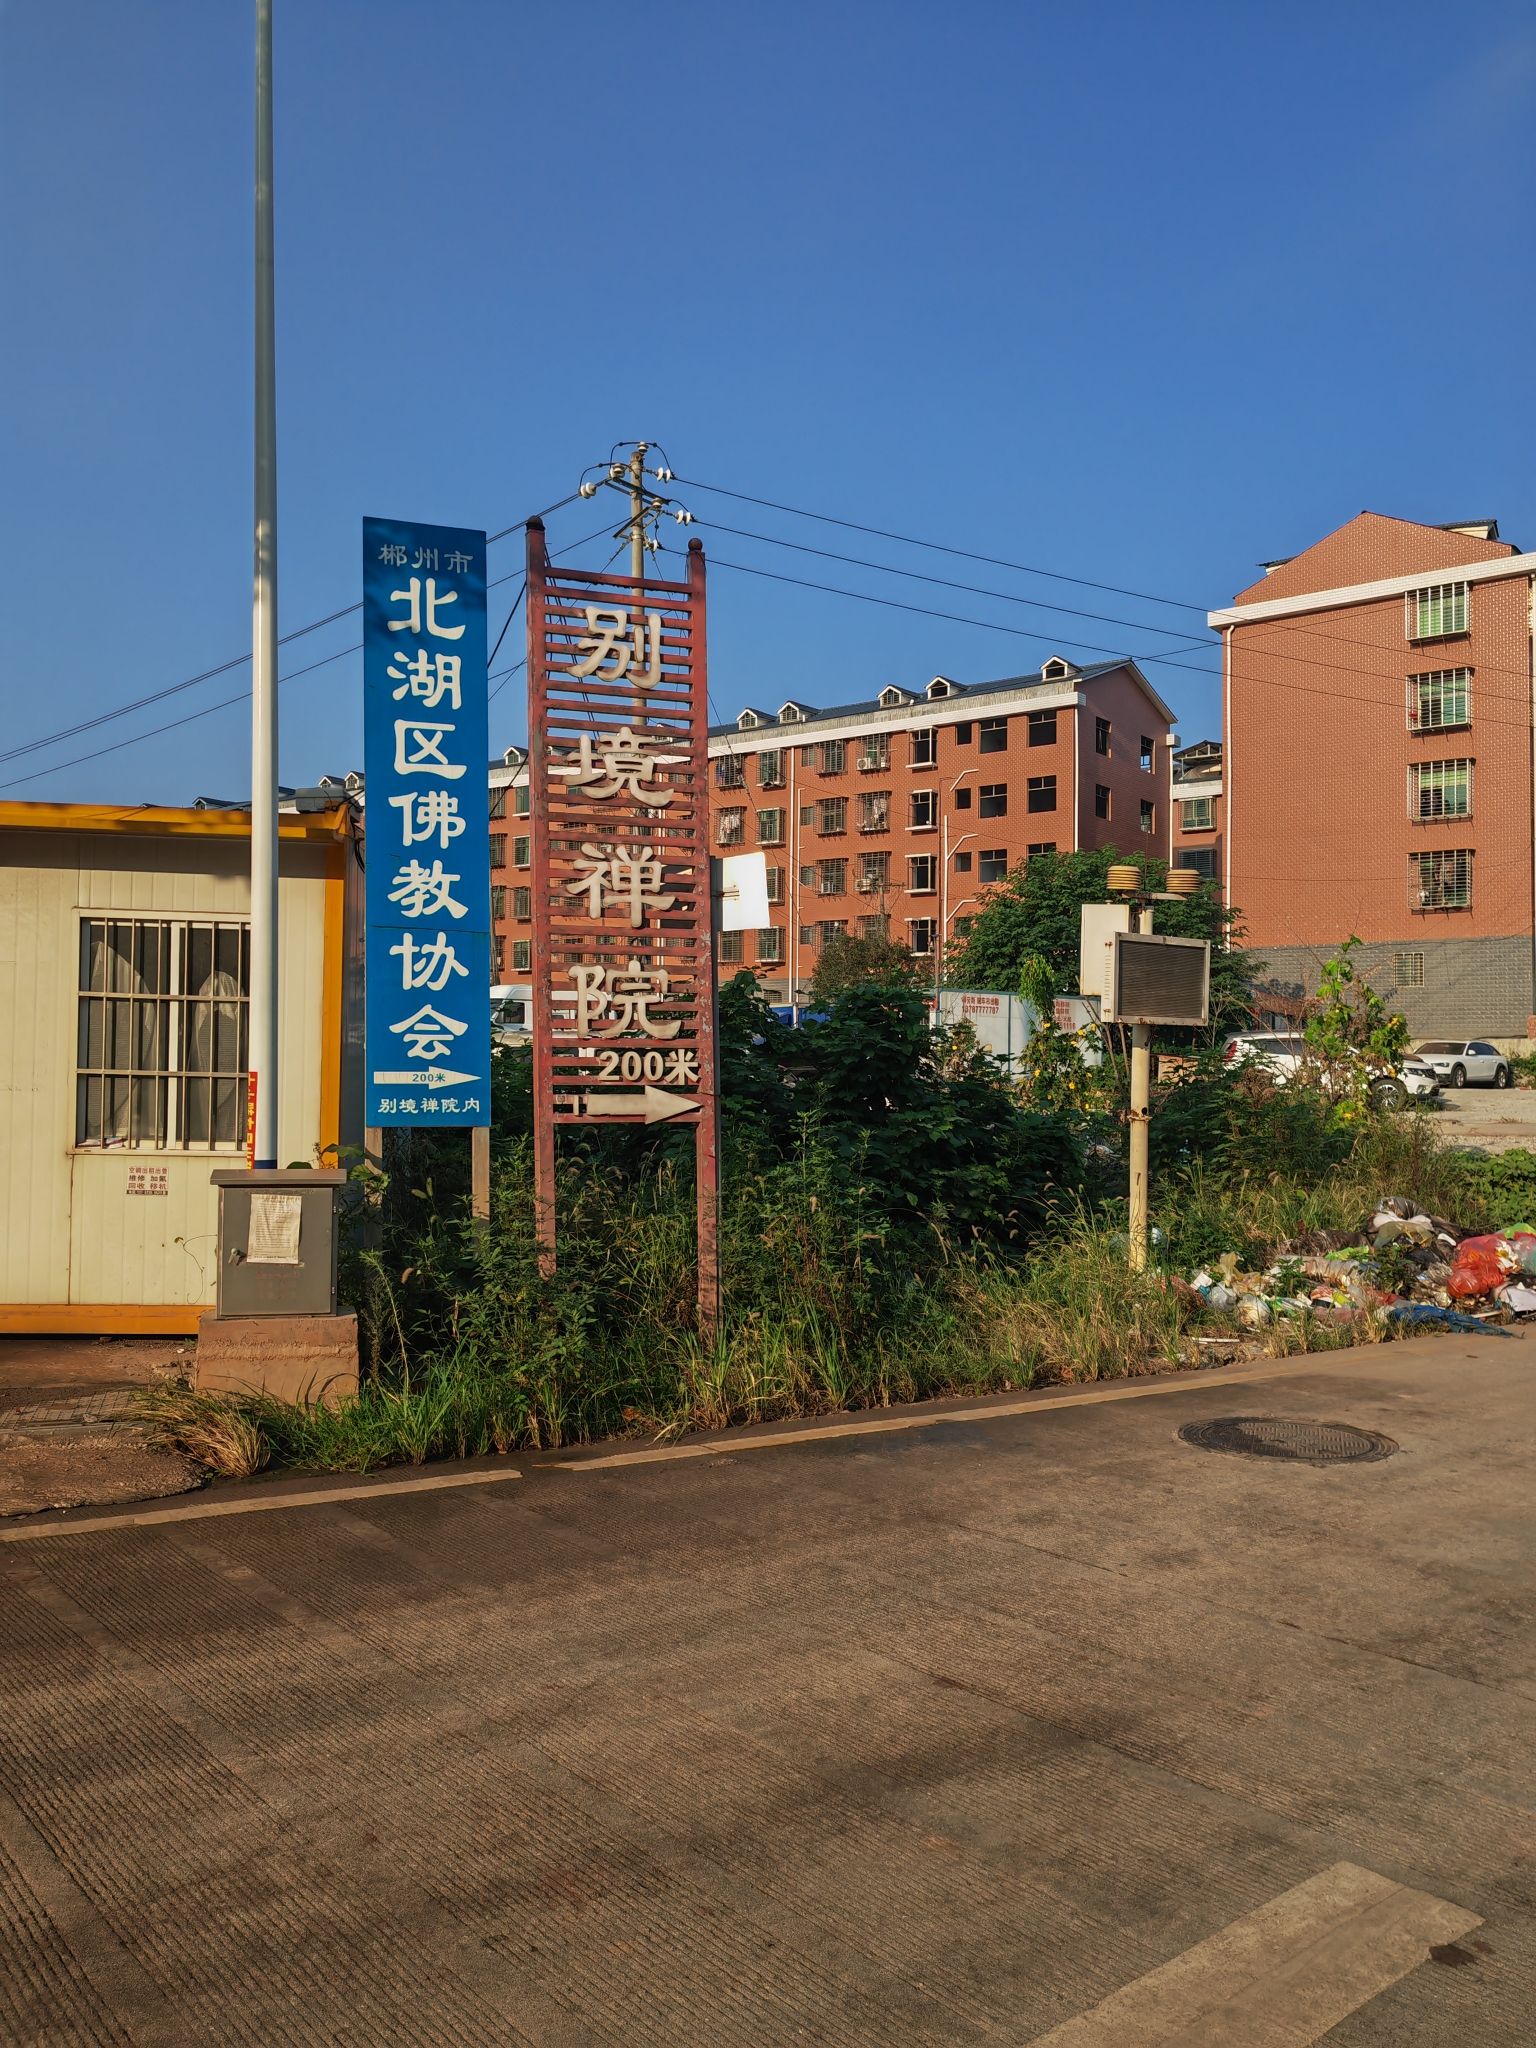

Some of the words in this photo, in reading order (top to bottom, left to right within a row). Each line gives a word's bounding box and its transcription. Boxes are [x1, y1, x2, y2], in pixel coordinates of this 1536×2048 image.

[378, 544, 473, 574] 郴州市
[387, 577, 469, 1060] 北湖区佛教协会
[561, 606, 682, 1040] 别境禅院
[412, 1073, 446, 1083] 200米
[598, 1048, 699, 1086] 200米
[378, 1097, 480, 1114] 别境禅院内
